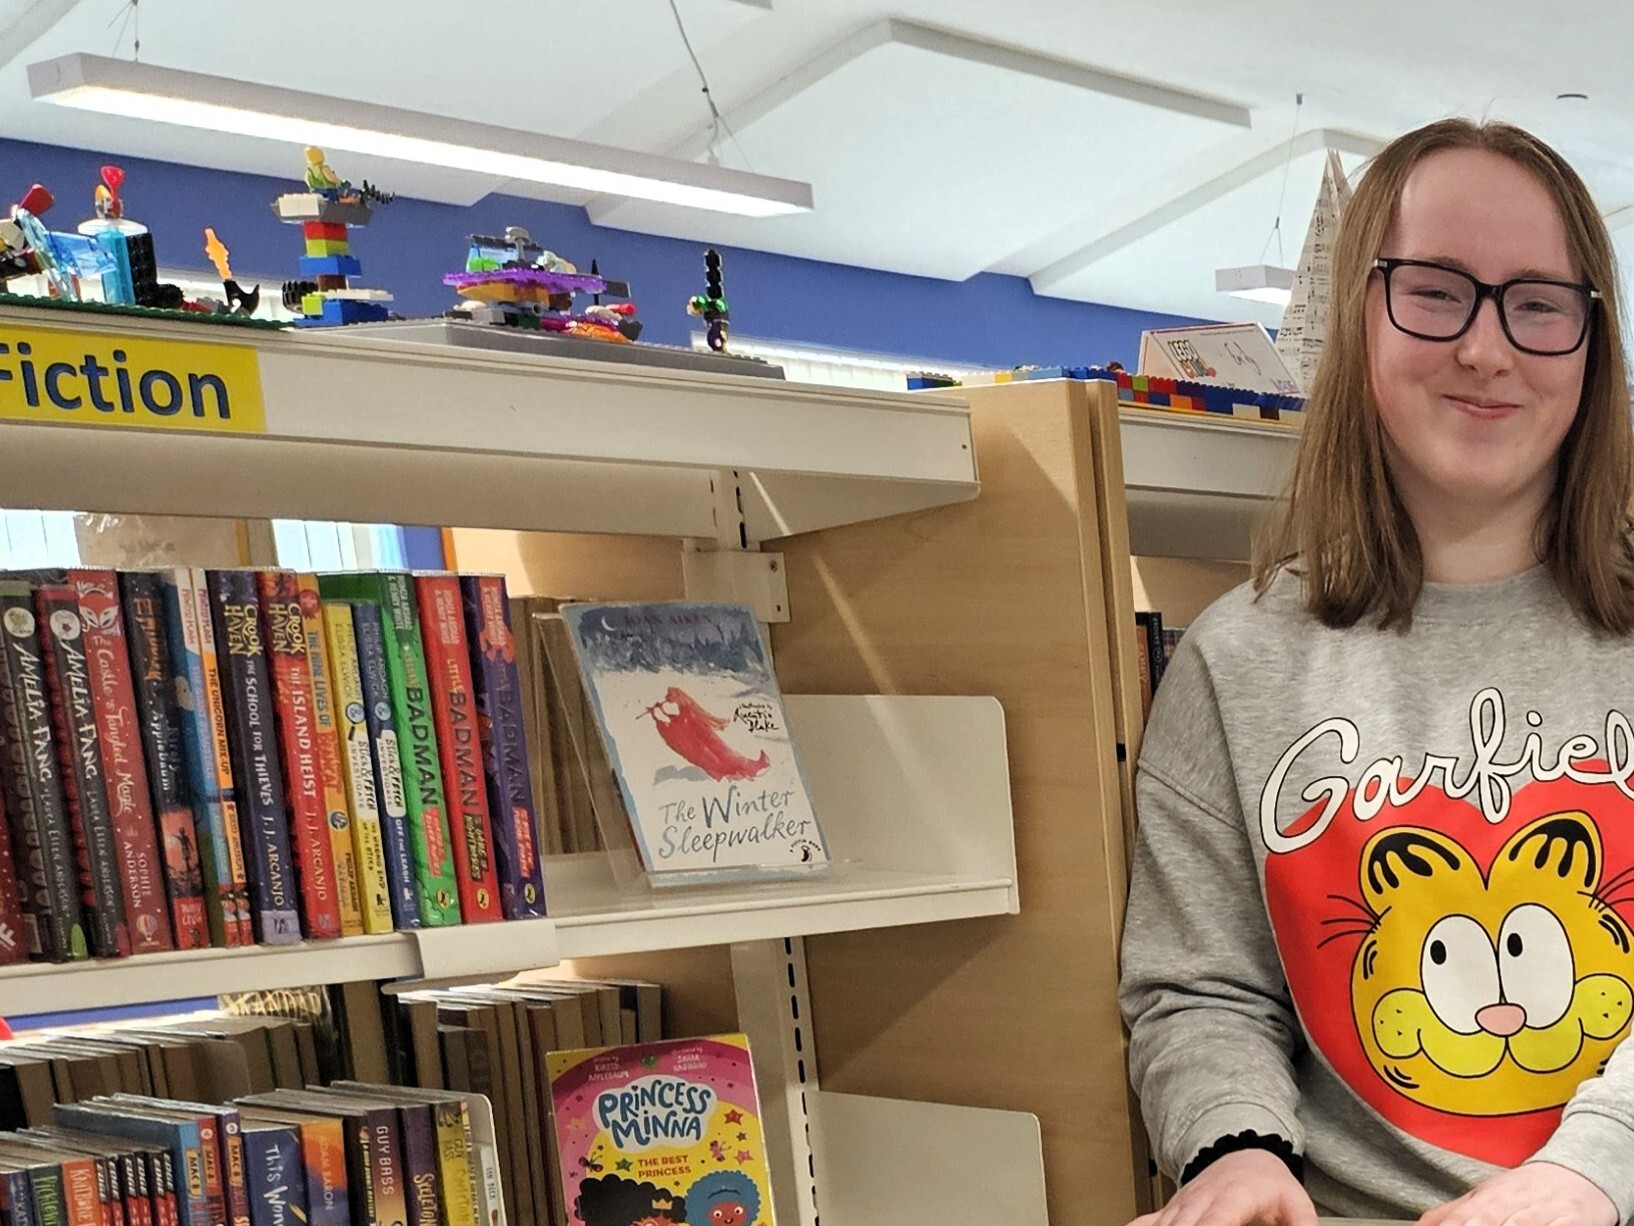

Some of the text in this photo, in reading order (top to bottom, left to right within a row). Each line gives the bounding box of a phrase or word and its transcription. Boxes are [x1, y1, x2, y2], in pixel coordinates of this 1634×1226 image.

[223, 603, 245, 656] HAVEN
[240, 603, 262, 657] CROOK
[268, 602, 287, 655] HAVEN
[286, 602, 305, 655] CROOK
[244, 676, 263, 727] SCHOOL
[31, 724, 54, 782] FANG
[103, 706, 133, 765] Tangled
[251, 731, 263, 752] FOR
[289, 667, 316, 798] THE ISLAND HEIST
[405, 685, 438, 807] BADMAN
[447, 691, 478, 807] BADMAN
[111, 768, 137, 816] Magic
[253, 754, 274, 806] THIEVES
[658, 784, 796, 828] The Winter
[304, 811, 327, 901] J. J. ARCANJO
[658, 810, 811, 862] Sleepwalker
[124, 840, 143, 909] ANDERSON
[136, 851, 153, 897] SOPHIE
[598, 1079, 712, 1128] PRINCESS
[612, 1110, 701, 1148] MINNA
[375, 1125, 396, 1195] GUY BASS
[638, 1154, 688, 1168] THE BEST
[638, 1166, 692, 1178] PRINCESS
